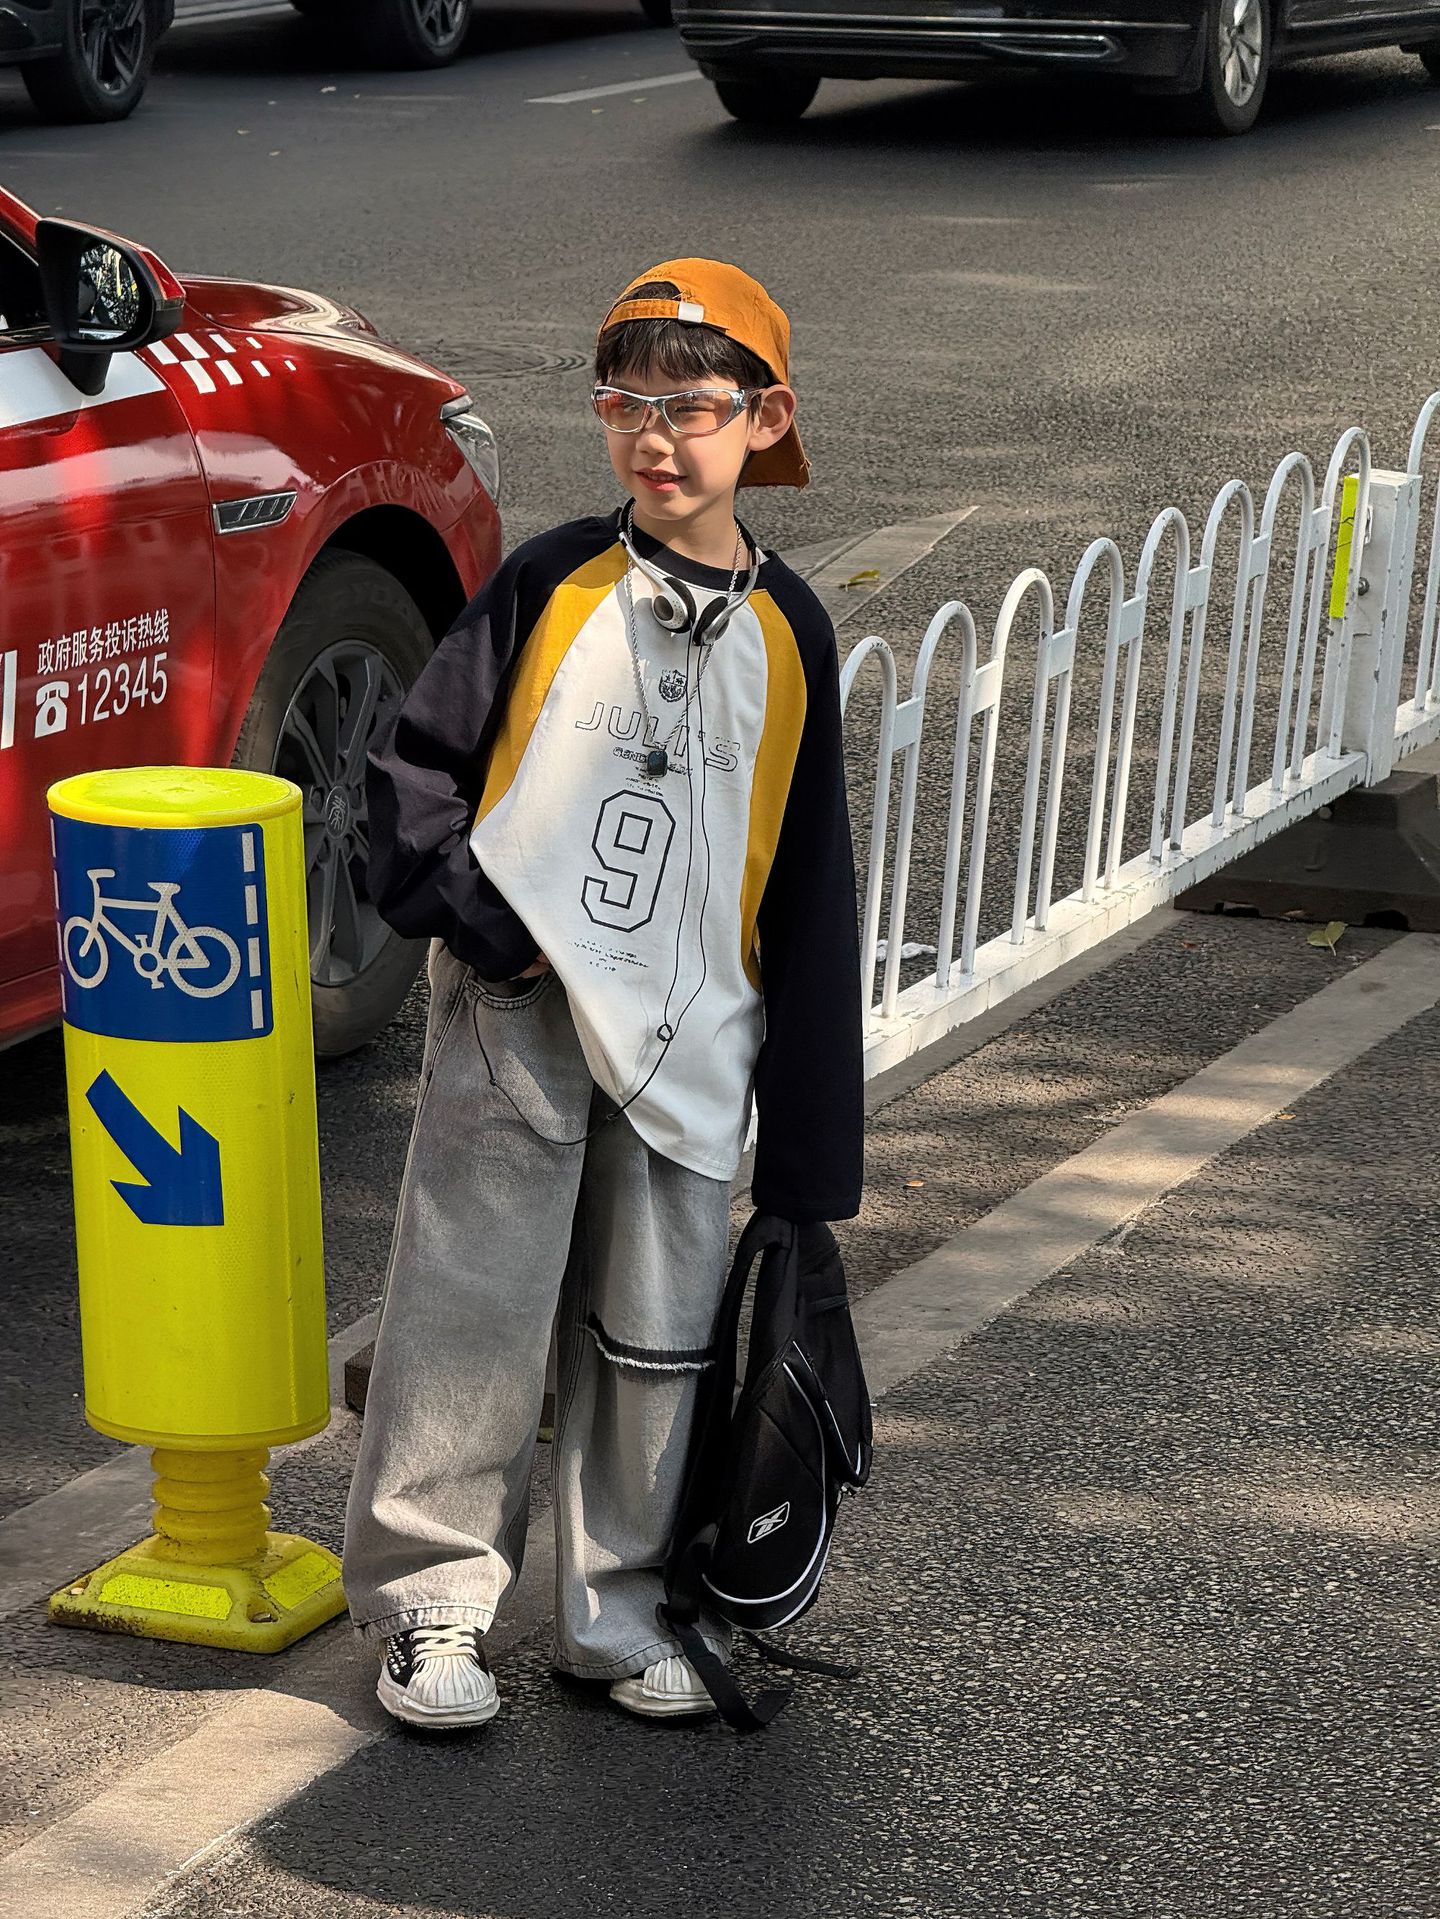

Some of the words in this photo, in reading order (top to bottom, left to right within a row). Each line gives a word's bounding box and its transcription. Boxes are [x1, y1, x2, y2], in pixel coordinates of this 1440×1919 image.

[37, 608, 170, 676] 政府服务投诉热线
[77, 652, 168, 725] 12345
[580, 789, 677, 933] 9
